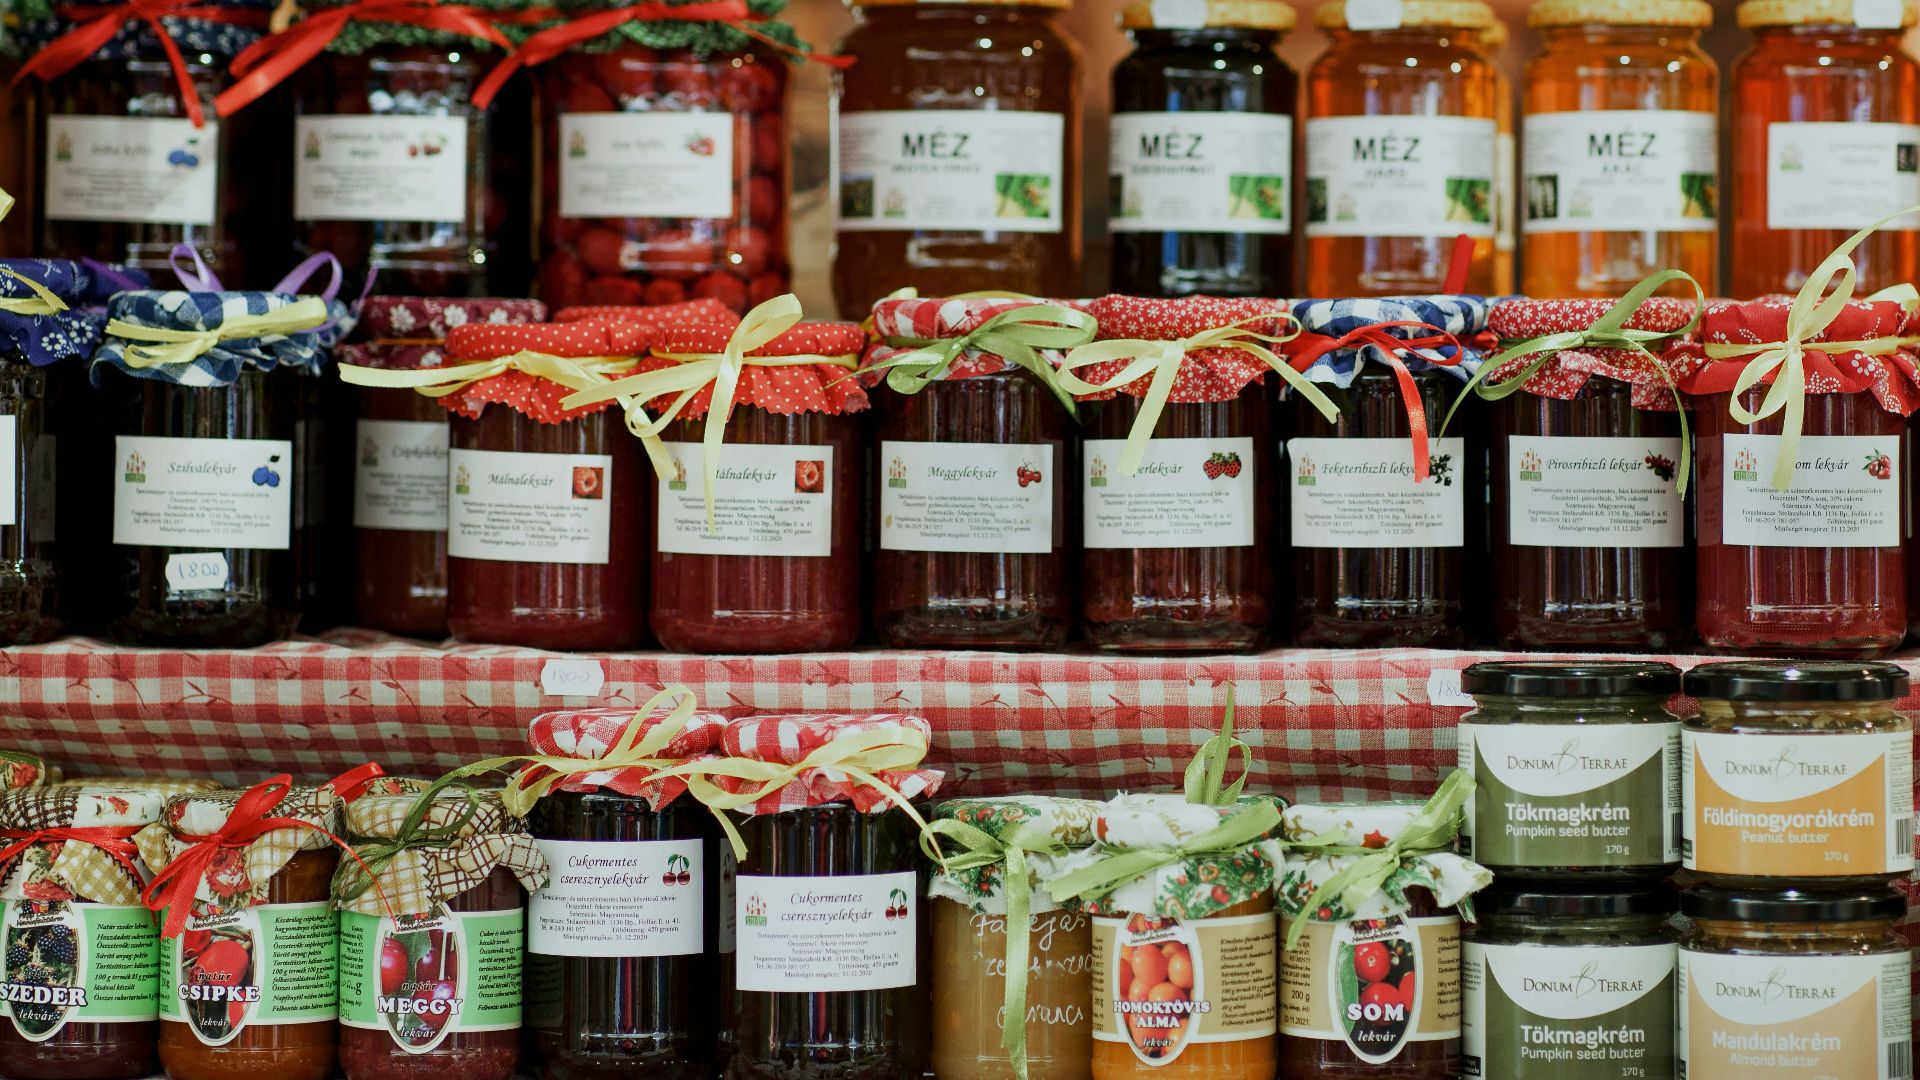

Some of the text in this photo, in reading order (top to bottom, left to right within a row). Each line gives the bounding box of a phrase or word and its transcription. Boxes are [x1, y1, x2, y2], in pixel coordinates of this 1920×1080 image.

[902, 127, 970, 158] MÉZ
[1139, 128, 1204, 158] MÉZ
[1353, 129, 1421, 161] MÉZ
[1589, 126, 1657, 157] MÉZ
[168, 461, 237, 476] Szilvalekvár
[928, 465, 998, 480] Meggylekvár
[1321, 462, 1416, 477] Feketeribizli lekv
[1547, 458, 1644, 473] Pirosribizli lekvár
[1795, 458, 1850, 472] om lekvár
[488, 473, 554, 489] Málnalekvár
[1507, 756, 1628, 770] DONUM TERRAE
[1505, 802, 1630, 826] Tökmagkrém
[1703, 807, 1874, 833] Földimogyorókrém
[1506, 825, 1630, 840] Pumpkin seed butter
[1742, 831, 1829, 844] Peanut butter
[1605, 845, 1622, 855] 170
[568, 855, 638, 869] Cukormentes
[560, 873, 649, 888] cseresznyelekvár
[790, 892, 863, 906] Cukormentes
[781, 909, 873, 924] cseresznyelekvár
[198, 971, 232, 982] natúr
[178, 984, 260, 1002] CSIPKE
[402, 980, 437, 991] natúr
[1523, 978, 1643, 993] DONUM TERRAE
[0, 981, 88, 1006] SZEDER
[1291, 990, 1305, 1000] 200
[378, 996, 463, 1015] MEGGY
[1347, 1003, 1405, 1021] SOM
[19, 1008, 55, 1021] lekvár
[201, 1018, 229, 1027] lekvár
[1136, 1016, 1181, 1029] ALMA
[400, 1027, 436, 1039] lekvár
[1357, 1030, 1397, 1042] lekvár
[1520, 1025, 1645, 1049] Tökmagkrém
[1712, 1030, 1841, 1051] Mandulakrém
[1143, 1037, 1174, 1047] lekvár
[1521, 1046, 1646, 1062] Pumpkin seed butter
[1729, 1054, 1820, 1067] Almond butter
[1621, 1067, 1638, 1077] 170
